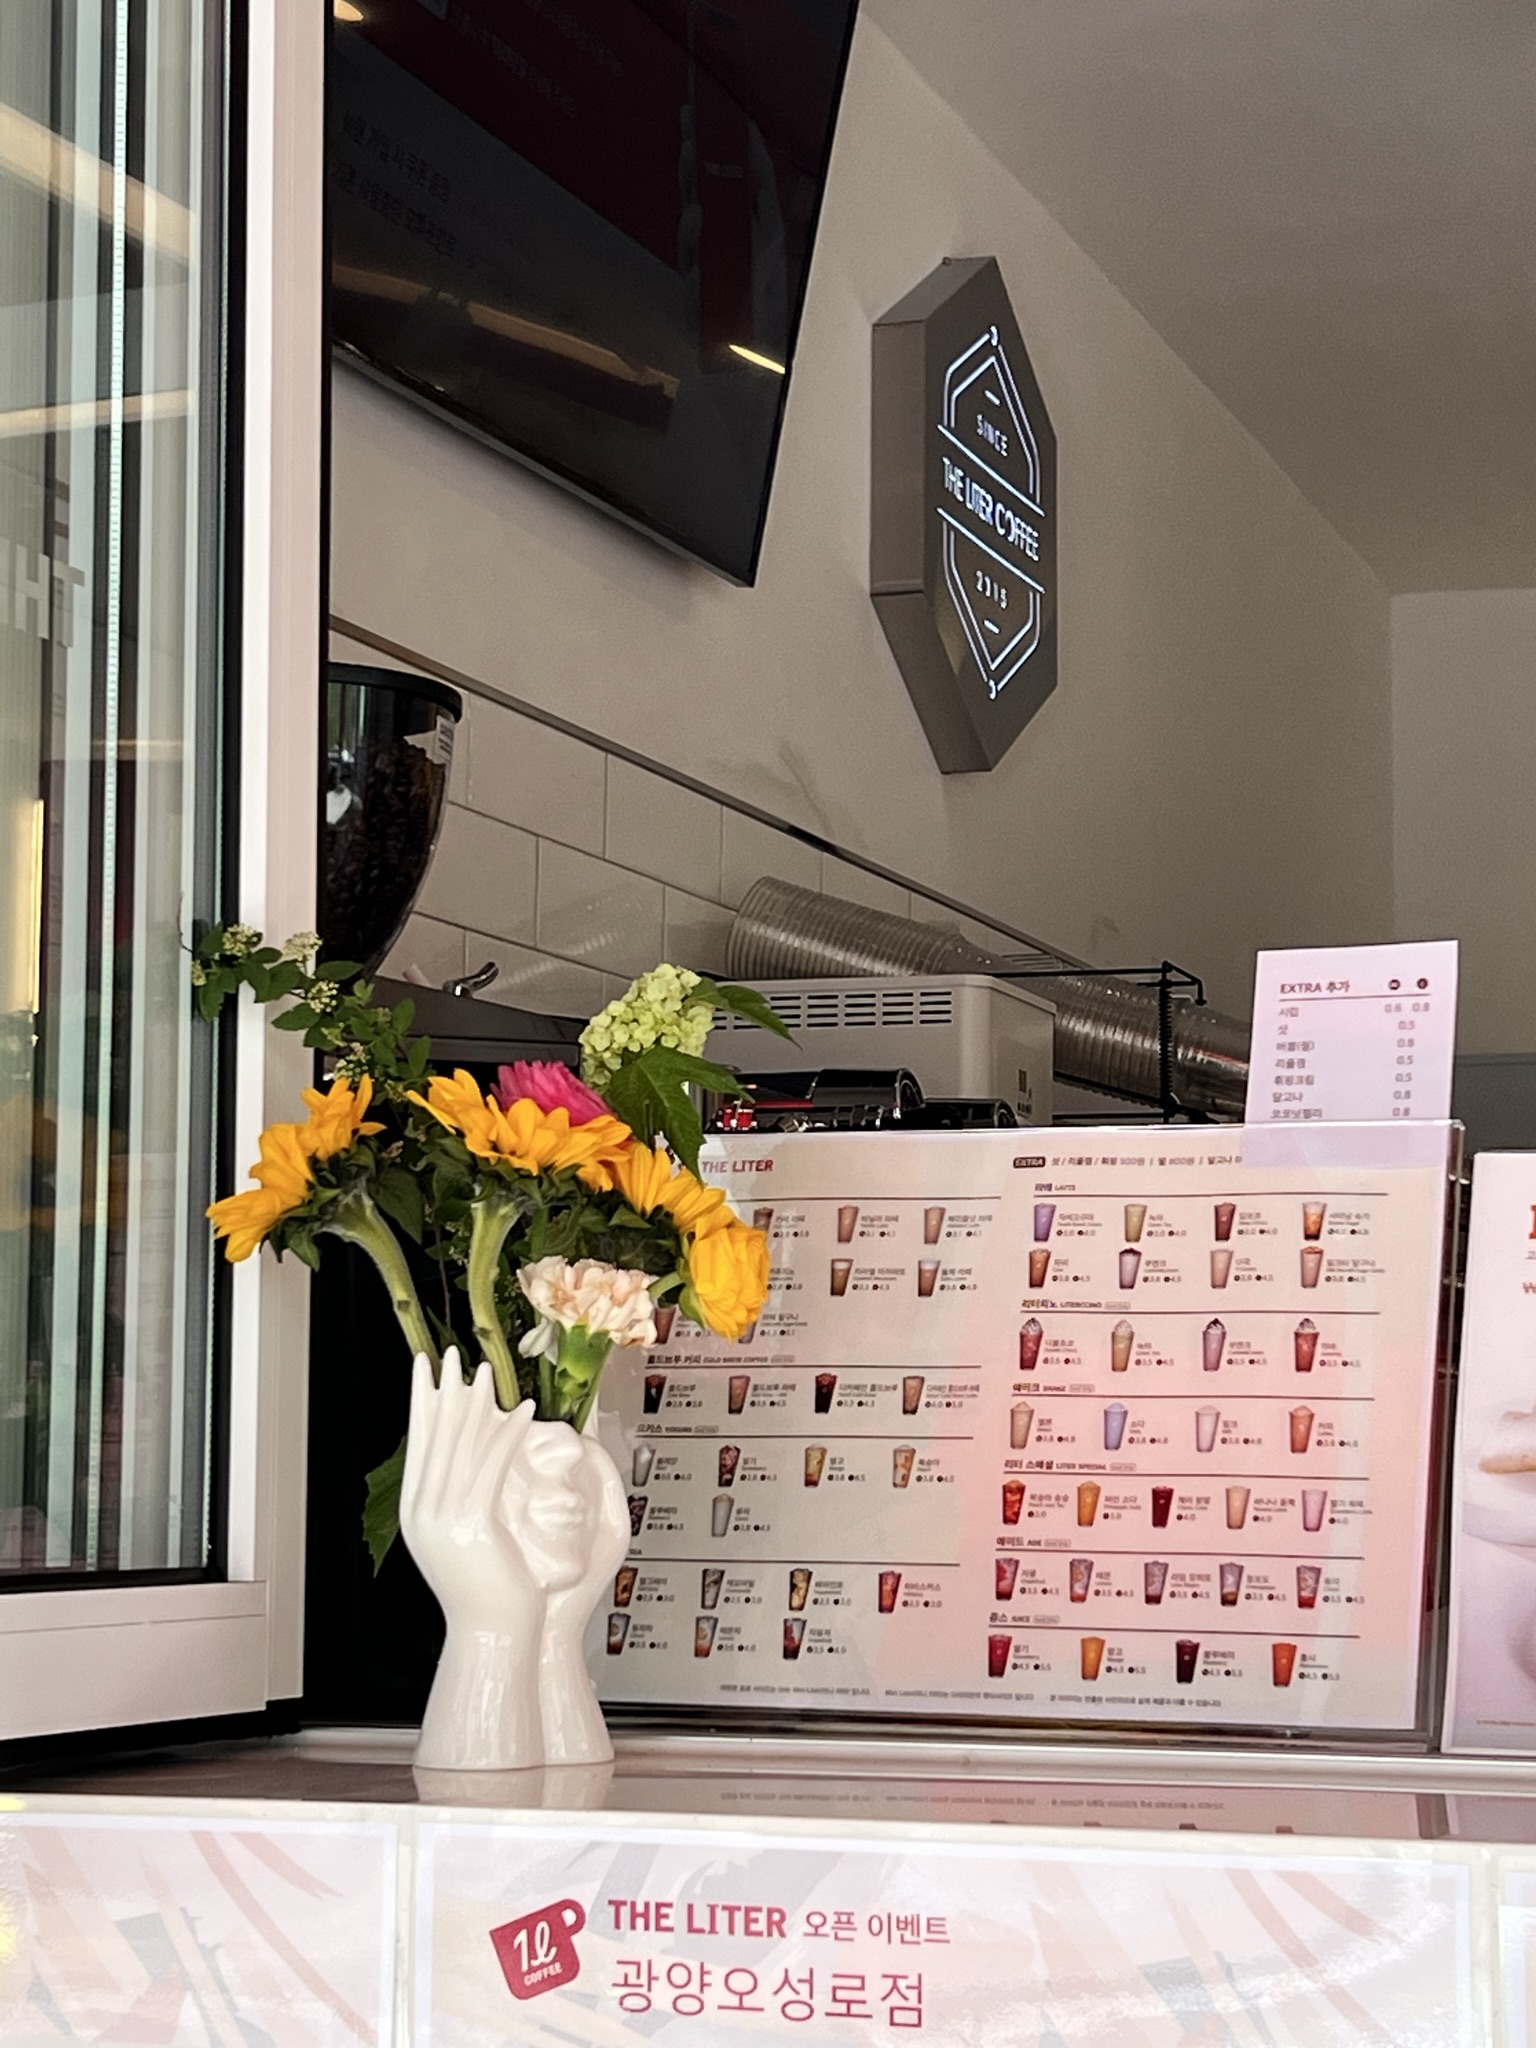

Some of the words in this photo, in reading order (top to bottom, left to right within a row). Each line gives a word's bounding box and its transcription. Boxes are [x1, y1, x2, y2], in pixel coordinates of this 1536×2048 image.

[975, 414, 1008, 457] SINCE
[942, 457, 965, 502] THE
[965, 475, 994, 525] LITER
[995, 502, 1039, 561] COFFEE
[1280, 982, 1322, 995] EXTRA
[701, 1160, 728, 1174] THE
[732, 1159, 774, 1173] LITER
[607, 1898, 675, 1932] THE
[686, 1902, 788, 1938] LITER
[802, 1910, 858, 1943] 오픈
[867, 1911, 952, 1945] 이벤트
[522, 1961, 563, 1988] COFFEE
[611, 1958, 924, 2028] 광양오성로점
